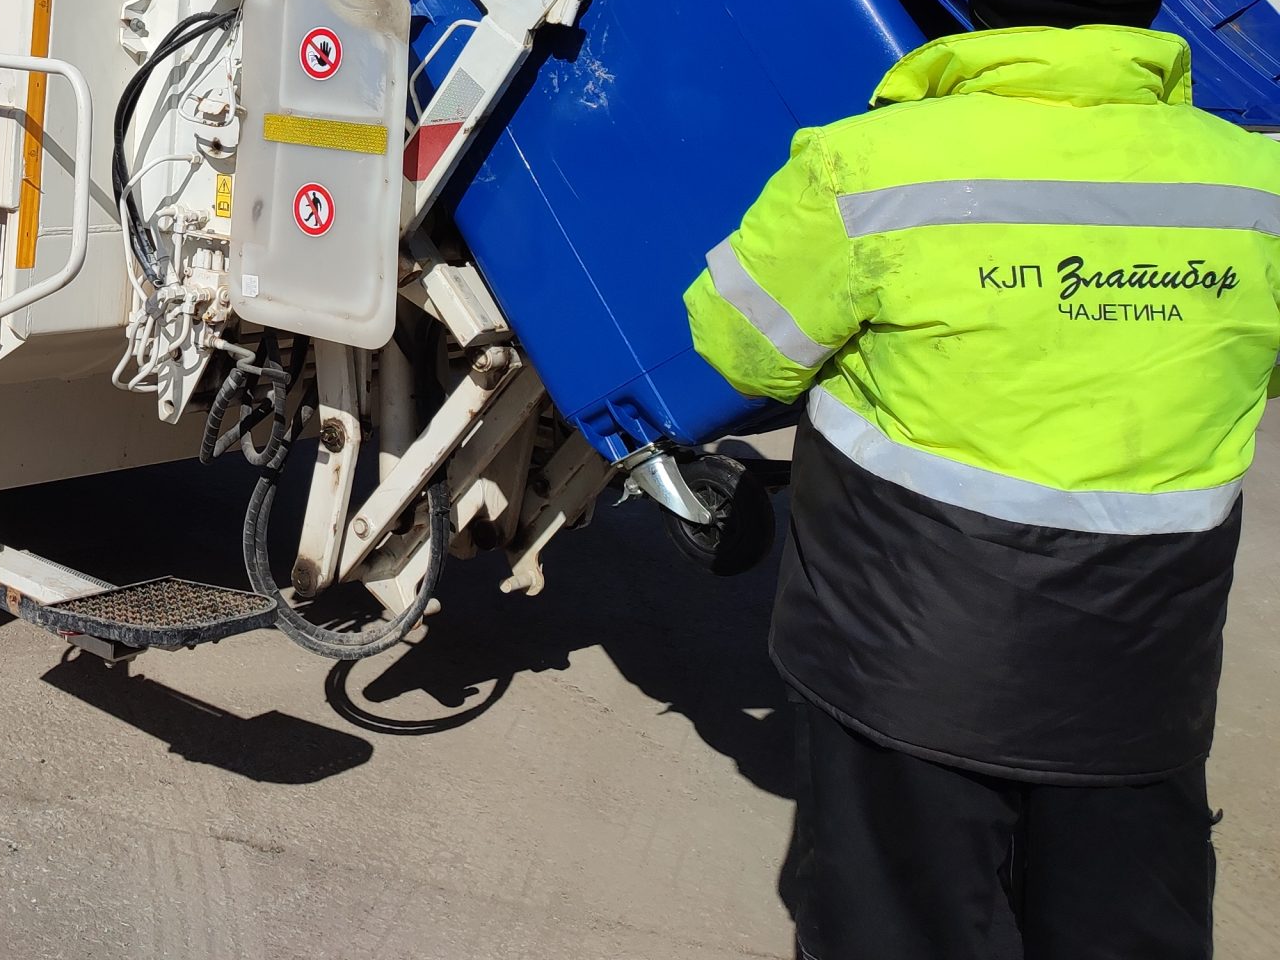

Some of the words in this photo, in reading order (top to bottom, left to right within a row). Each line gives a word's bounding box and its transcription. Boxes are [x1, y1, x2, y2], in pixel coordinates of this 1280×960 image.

[978, 265, 1043, 289] КЈП
[1056, 255, 1240, 300] Златибор
[1058, 303, 1183, 322] ЧАЈЕТИНА
